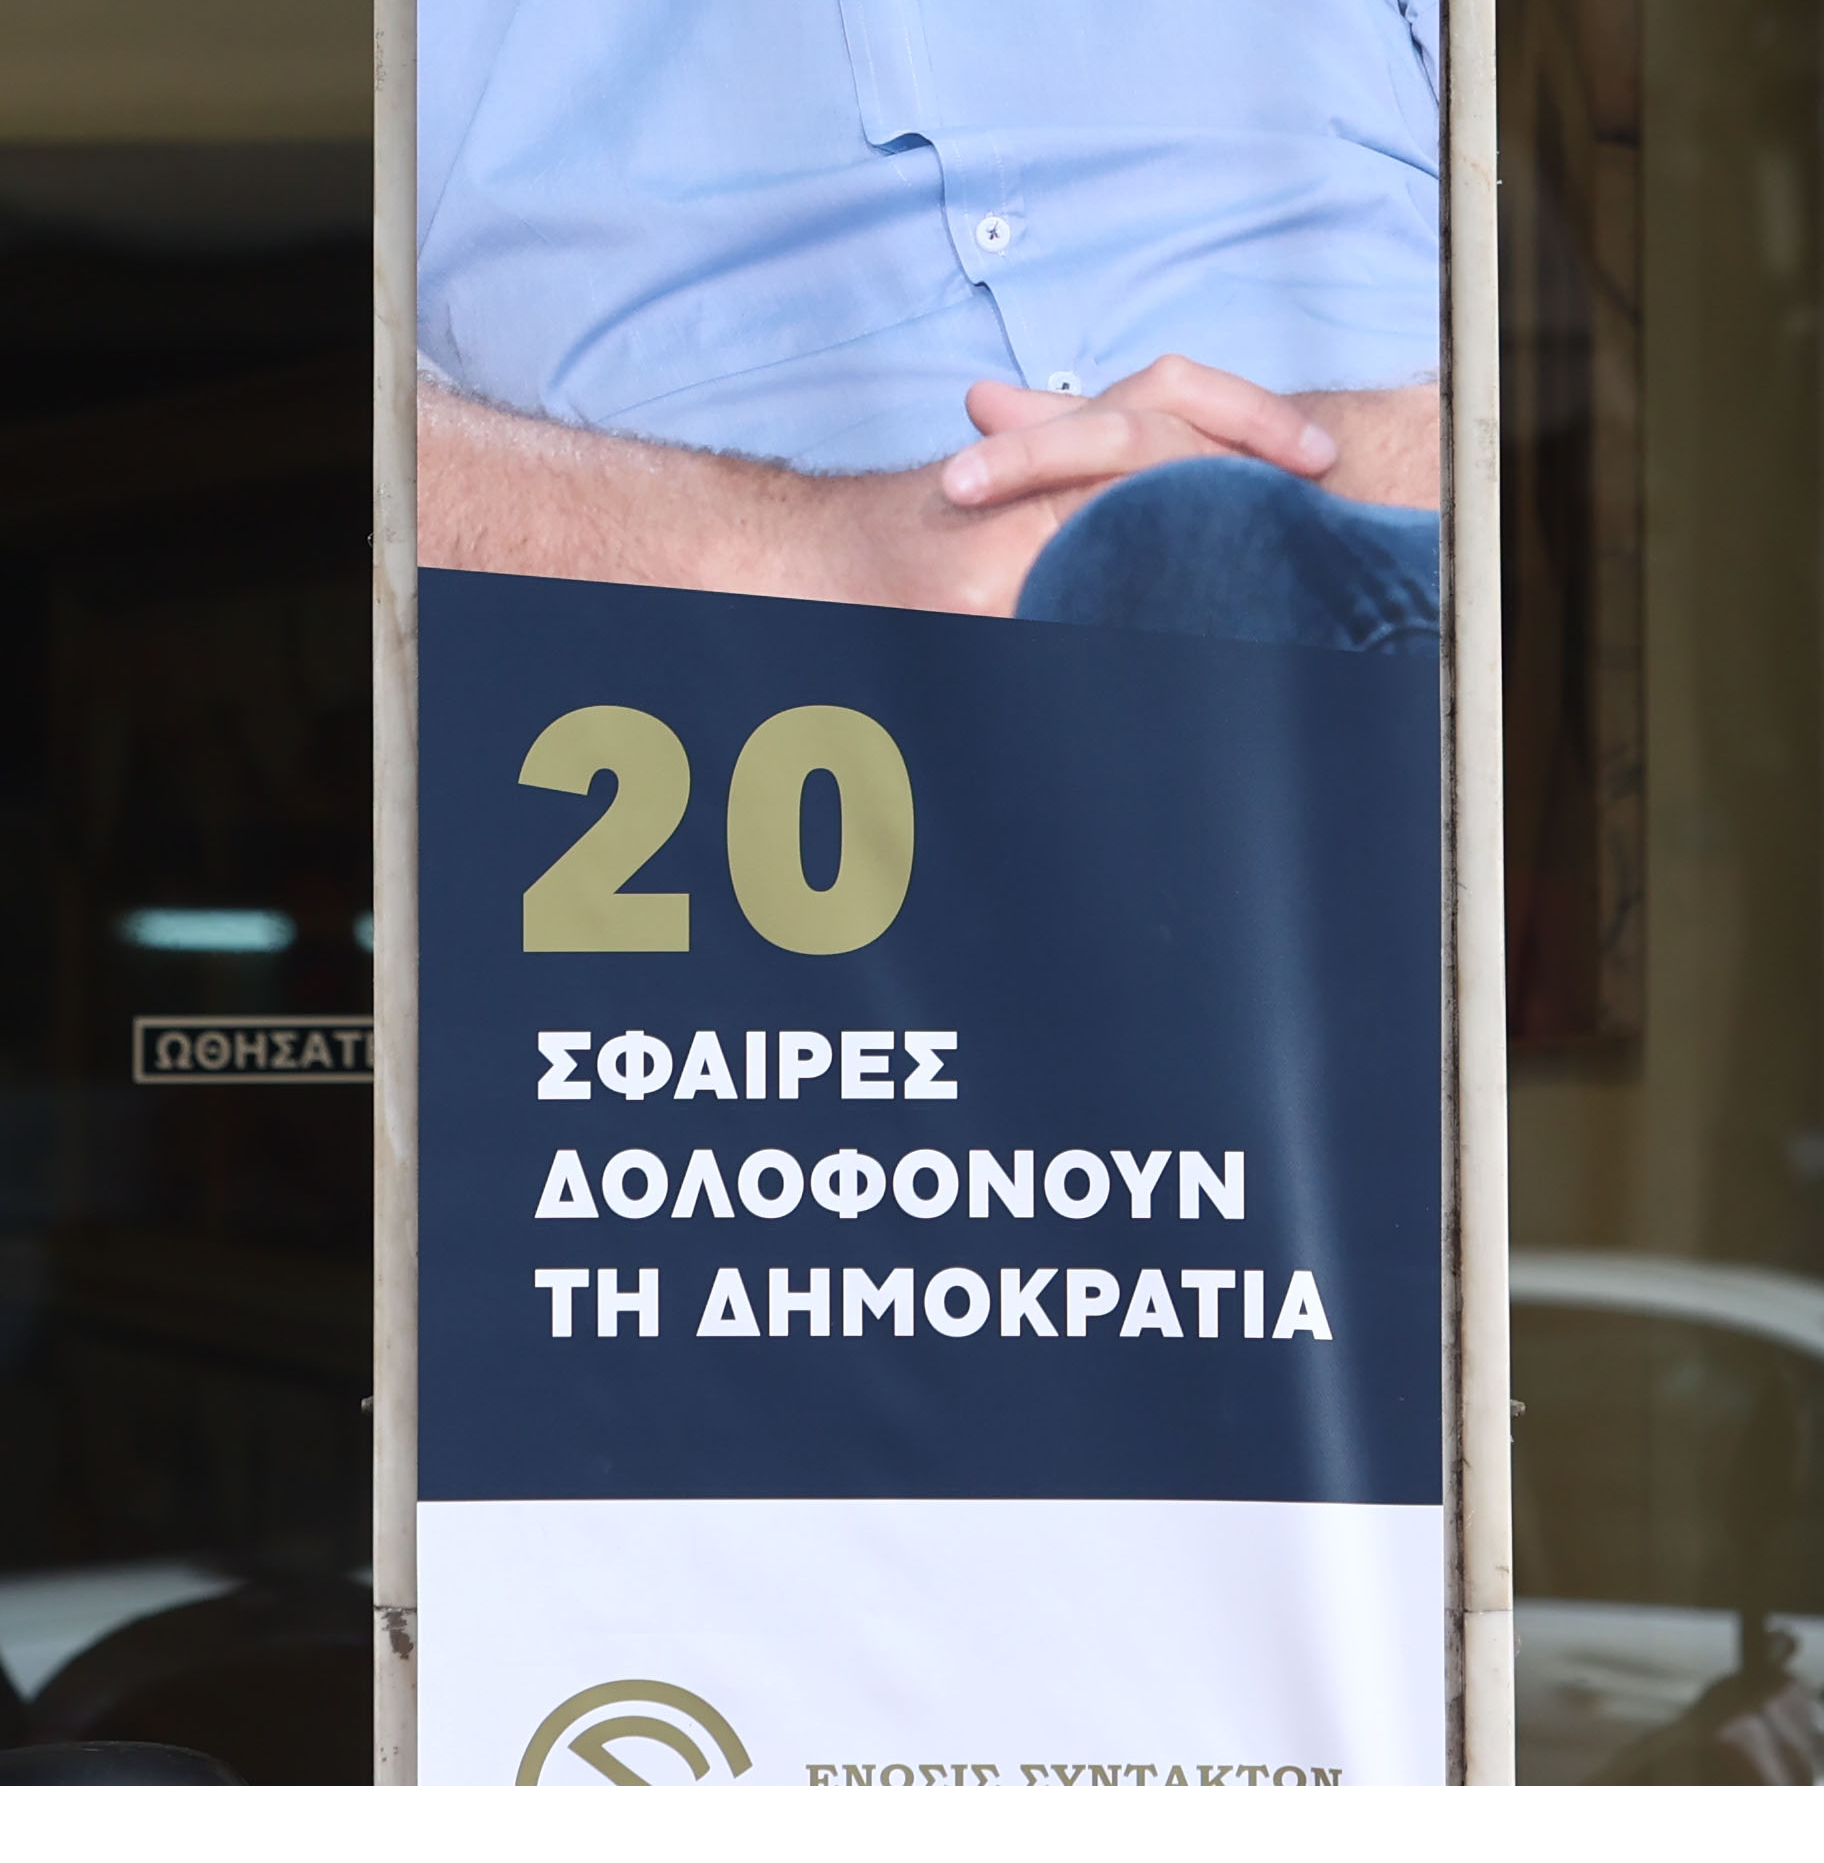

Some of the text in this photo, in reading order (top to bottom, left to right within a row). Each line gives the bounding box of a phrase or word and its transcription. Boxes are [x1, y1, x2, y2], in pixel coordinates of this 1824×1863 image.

[517, 704, 916, 956] 20
[536, 1029, 959, 1101] ΣΦΑΙΡΕΣ
[534, 1148, 1246, 1221] ΔΟΛΟΦΟΝΟΥΝ
[534, 1266, 1333, 1340] ΤΗ ΔΗΜΟΚΡΑΤΙΑ
